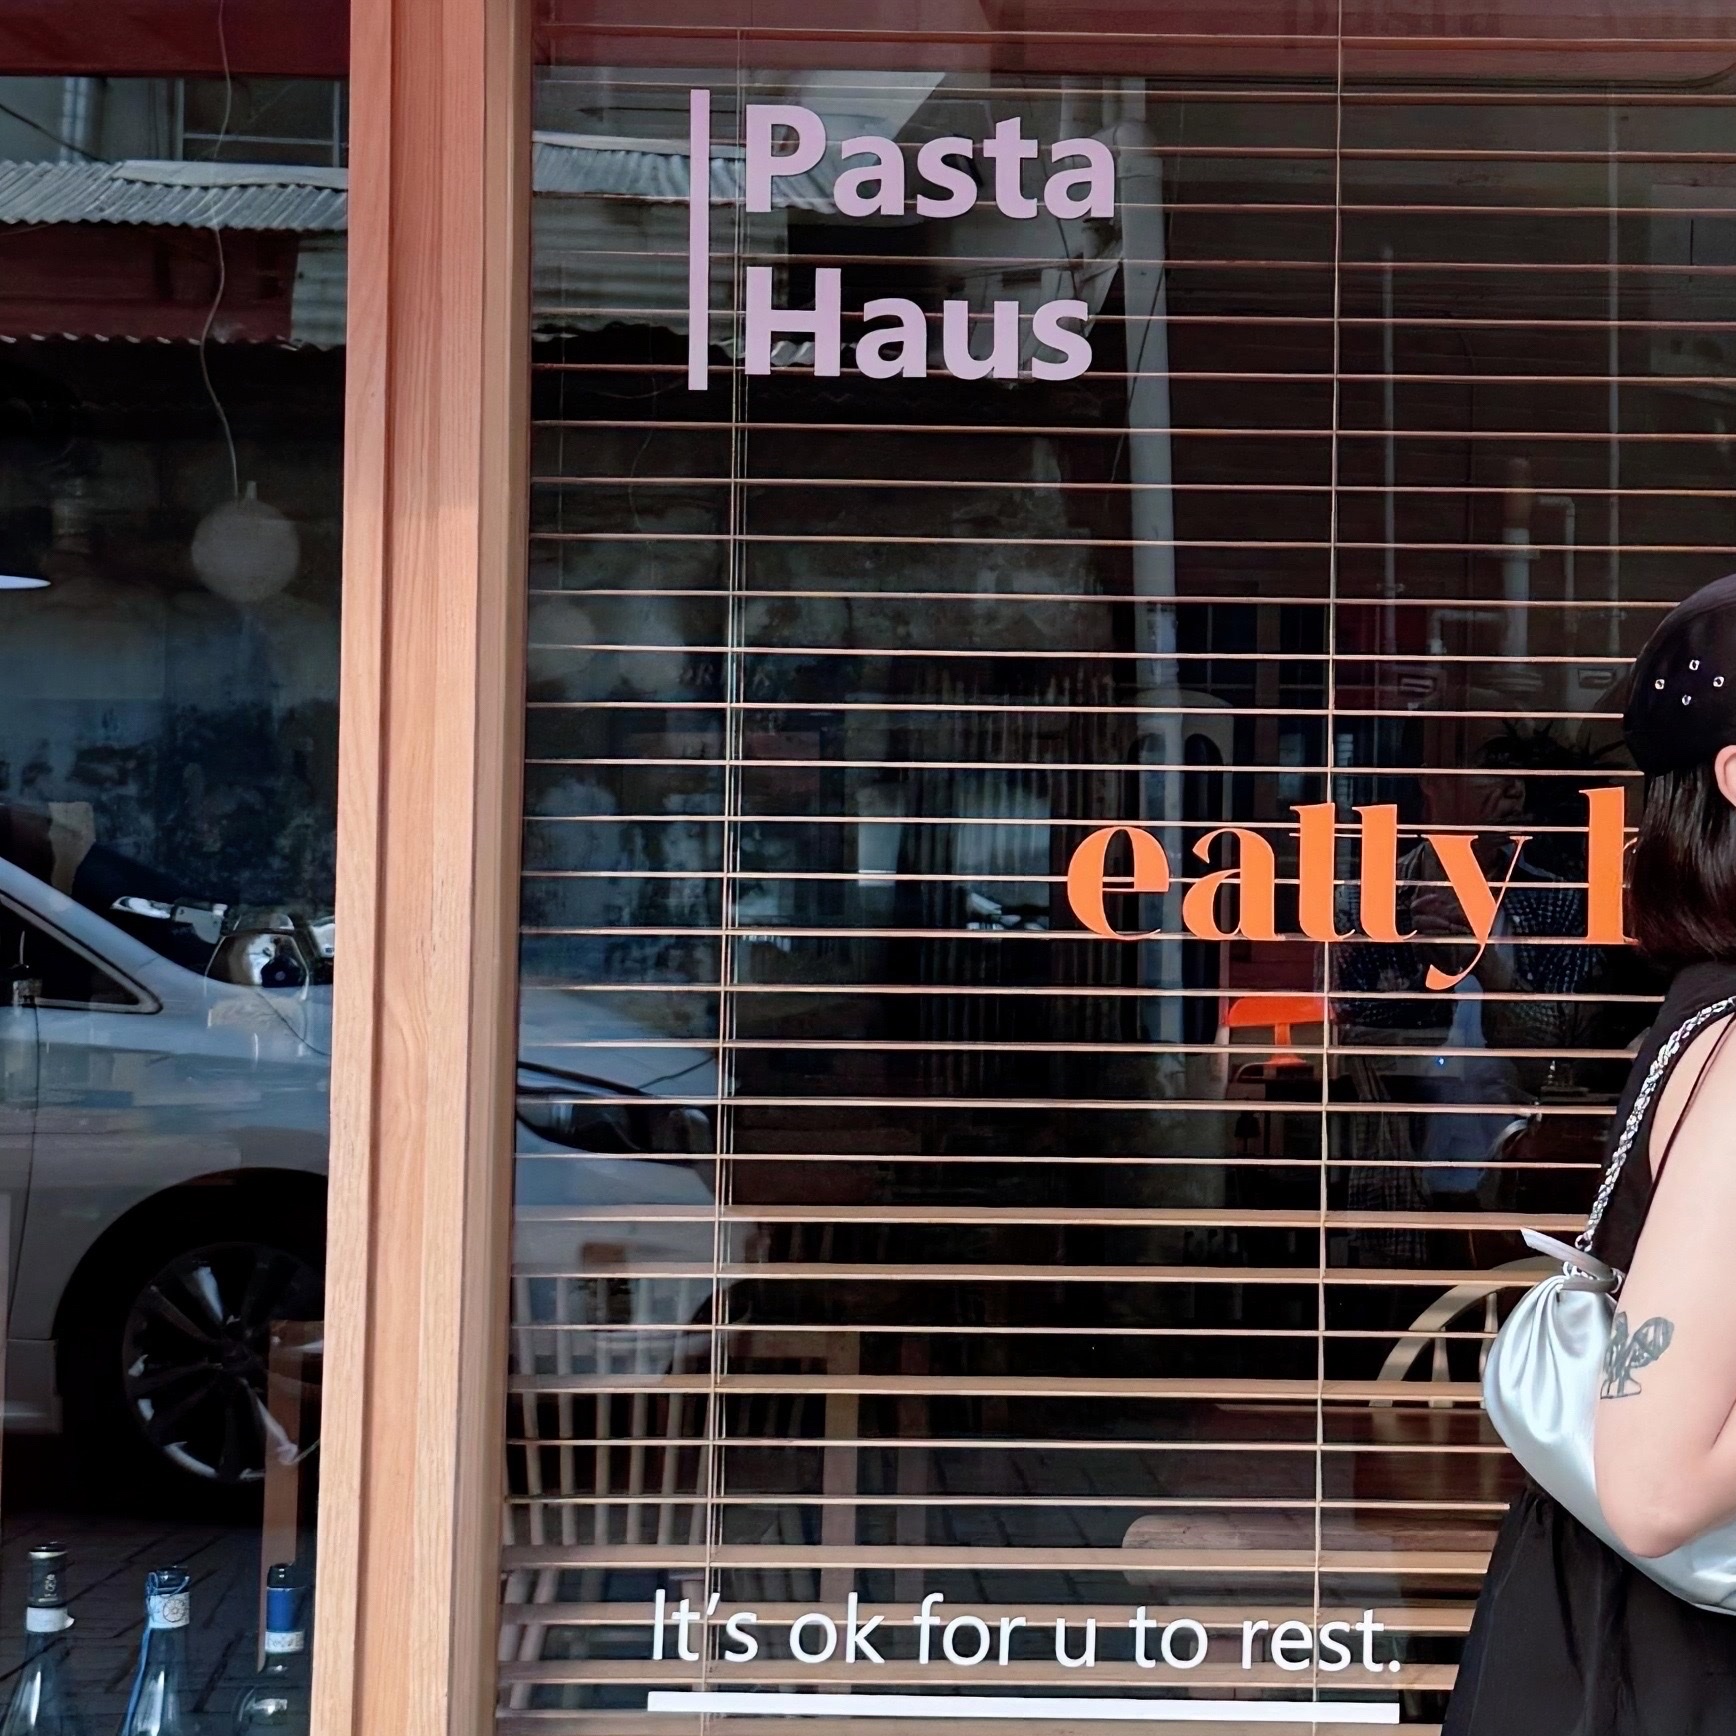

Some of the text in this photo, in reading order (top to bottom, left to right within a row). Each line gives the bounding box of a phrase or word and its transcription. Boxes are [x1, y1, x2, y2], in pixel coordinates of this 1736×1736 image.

[744, 103, 1116, 221] Pasta
[744, 265, 1093, 382] Haus
[1067, 802, 1534, 991] eatty
[652, 1588, 1401, 1673] It's ok for u to rest.
